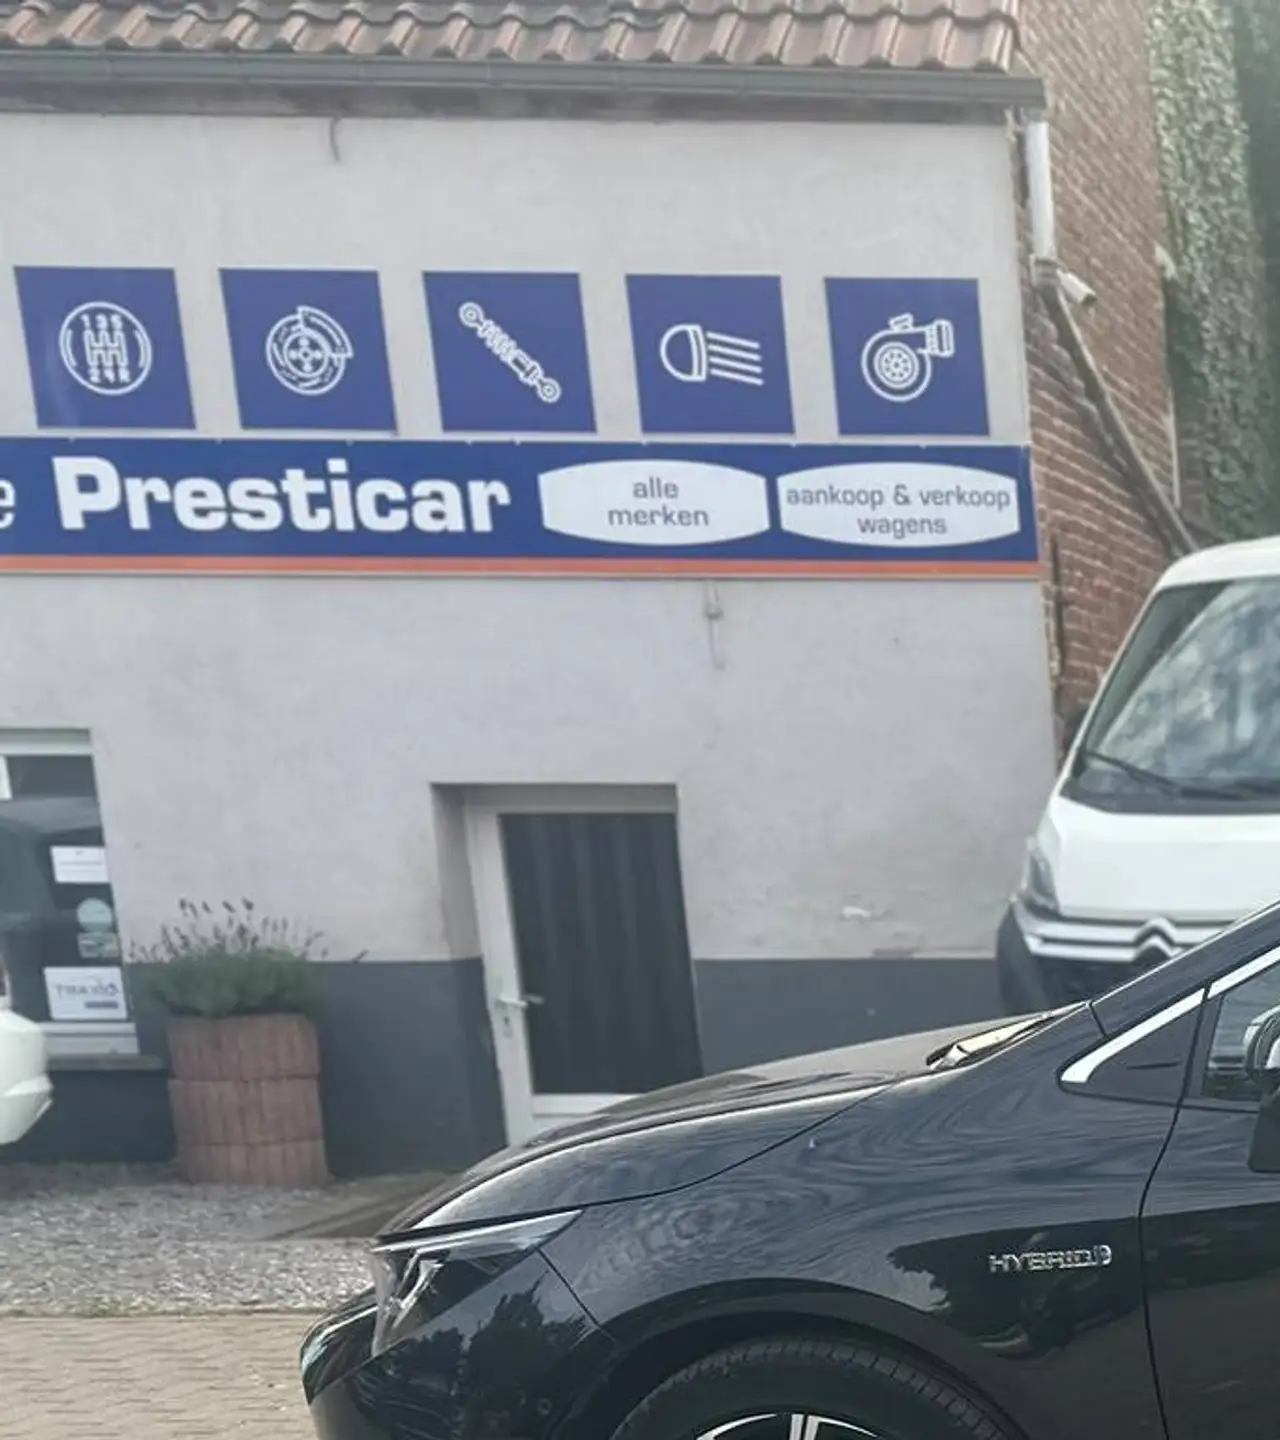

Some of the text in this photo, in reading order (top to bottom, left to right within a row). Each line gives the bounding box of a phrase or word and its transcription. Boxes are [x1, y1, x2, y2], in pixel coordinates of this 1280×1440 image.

[52, 456, 511, 532] Presticar
[632, 476, 680, 499] alle
[786, 484, 1011, 512] aankoop & verkoop
[607, 505, 709, 526] merken
[857, 518, 948, 540] wagens
